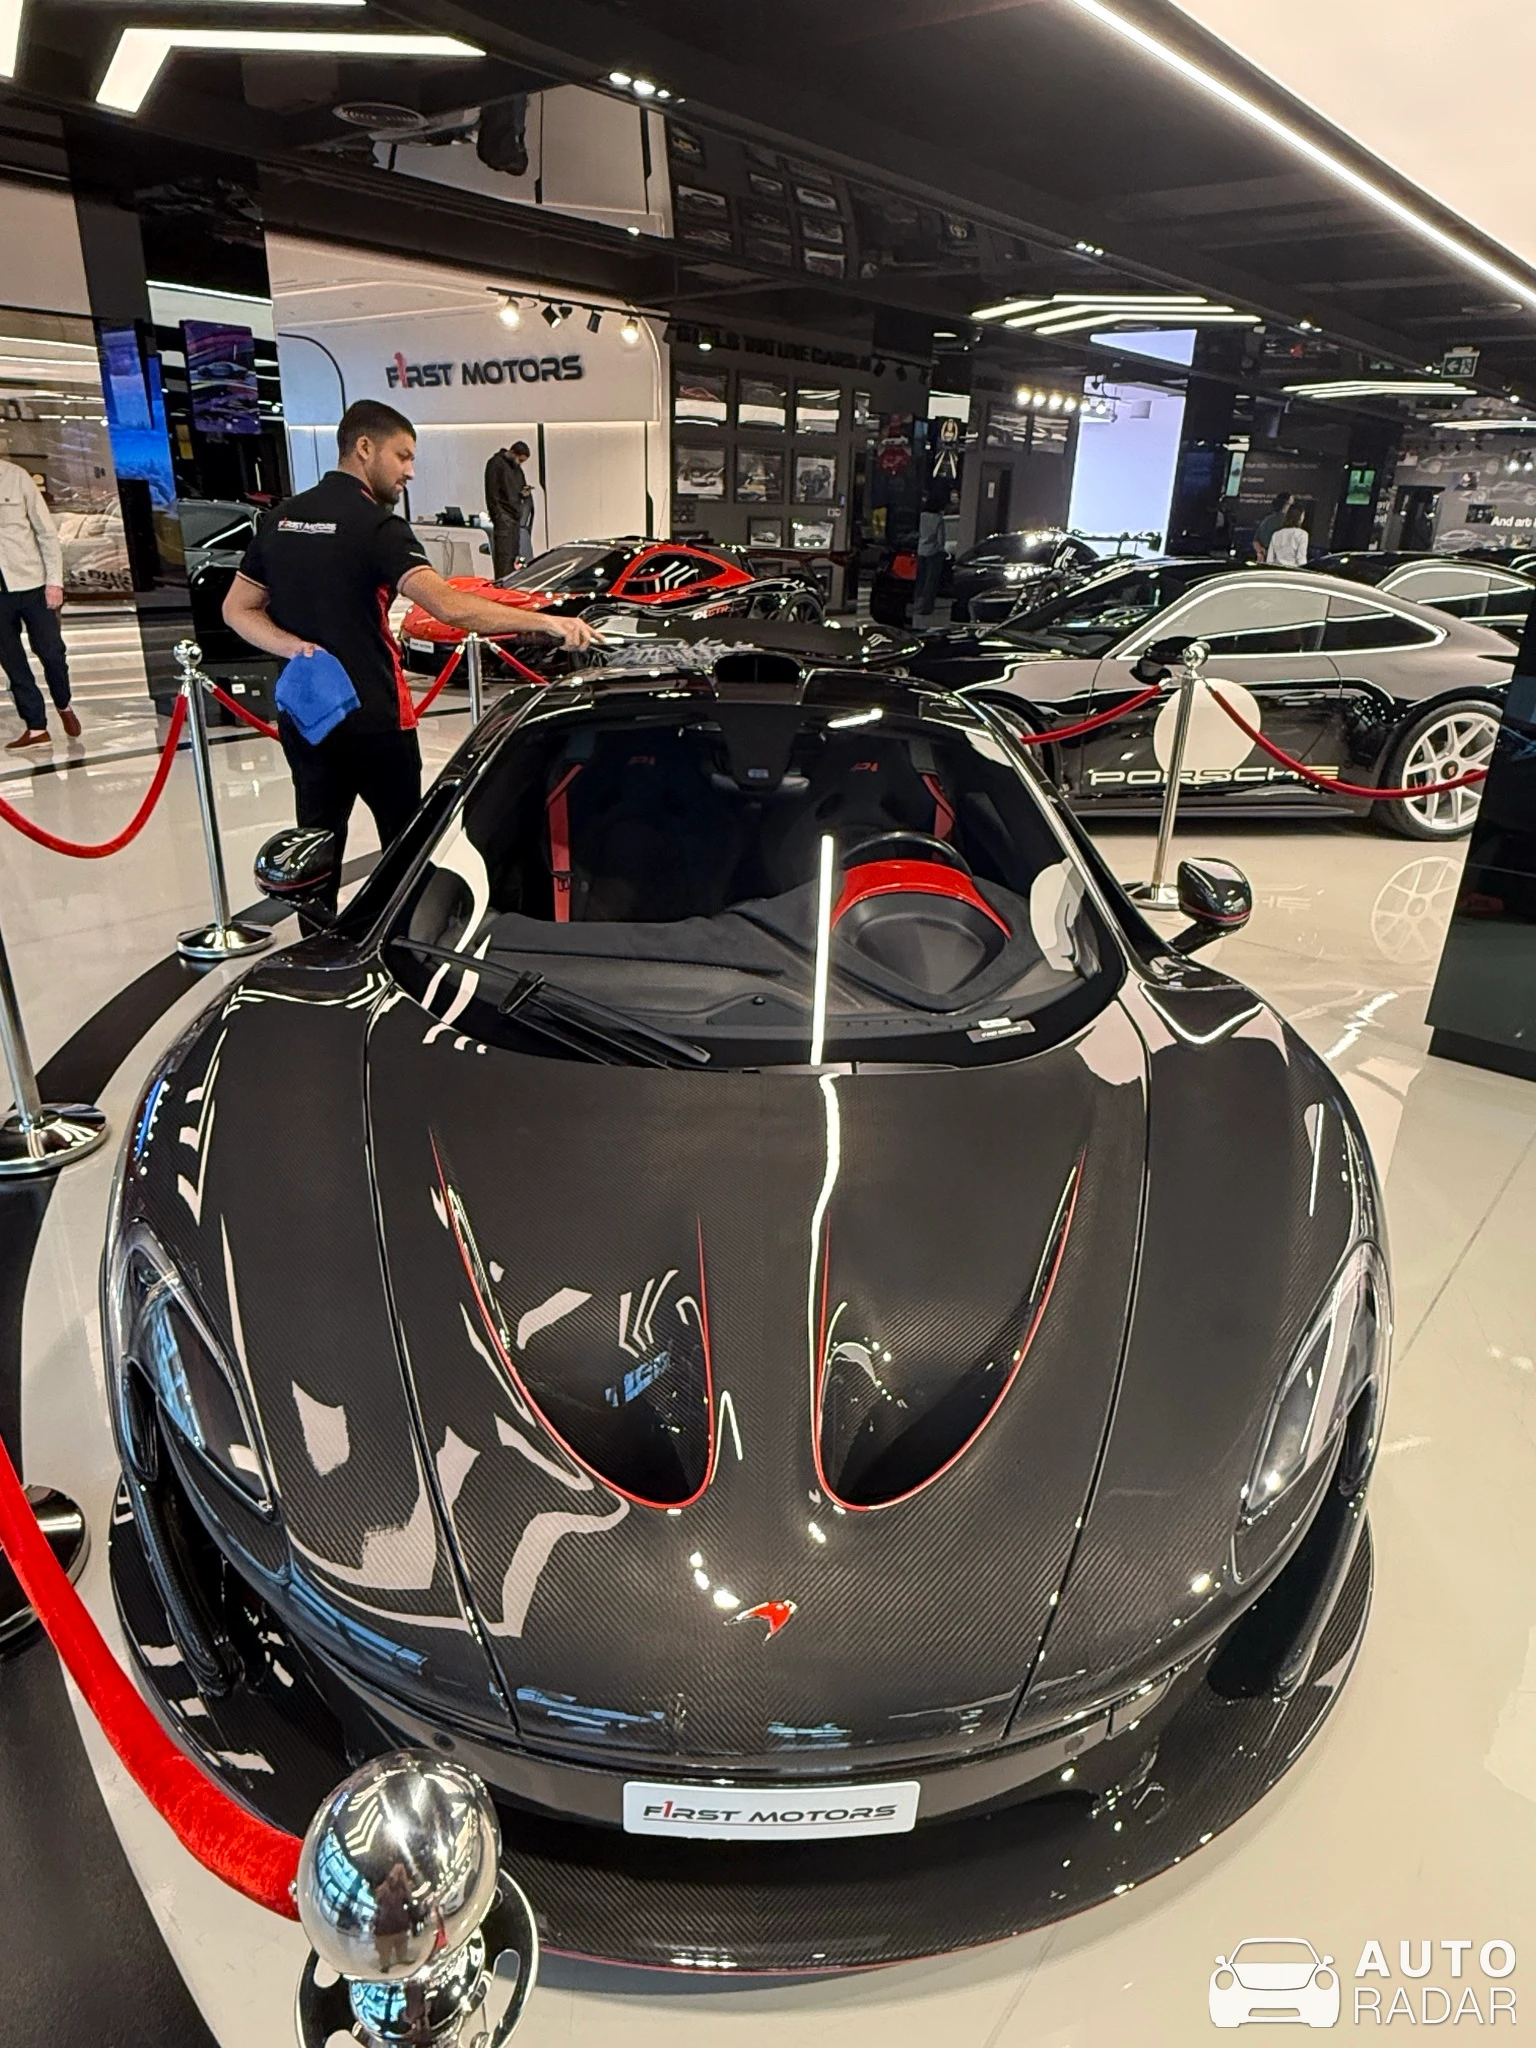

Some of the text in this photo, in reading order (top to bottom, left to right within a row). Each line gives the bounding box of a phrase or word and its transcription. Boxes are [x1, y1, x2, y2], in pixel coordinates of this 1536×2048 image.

[461, 355, 583, 386] MOTORS
[1490, 515, 1514, 527] And
[1514, 516, 1533, 528] art
[748, 1804, 898, 1823] MOTORS
